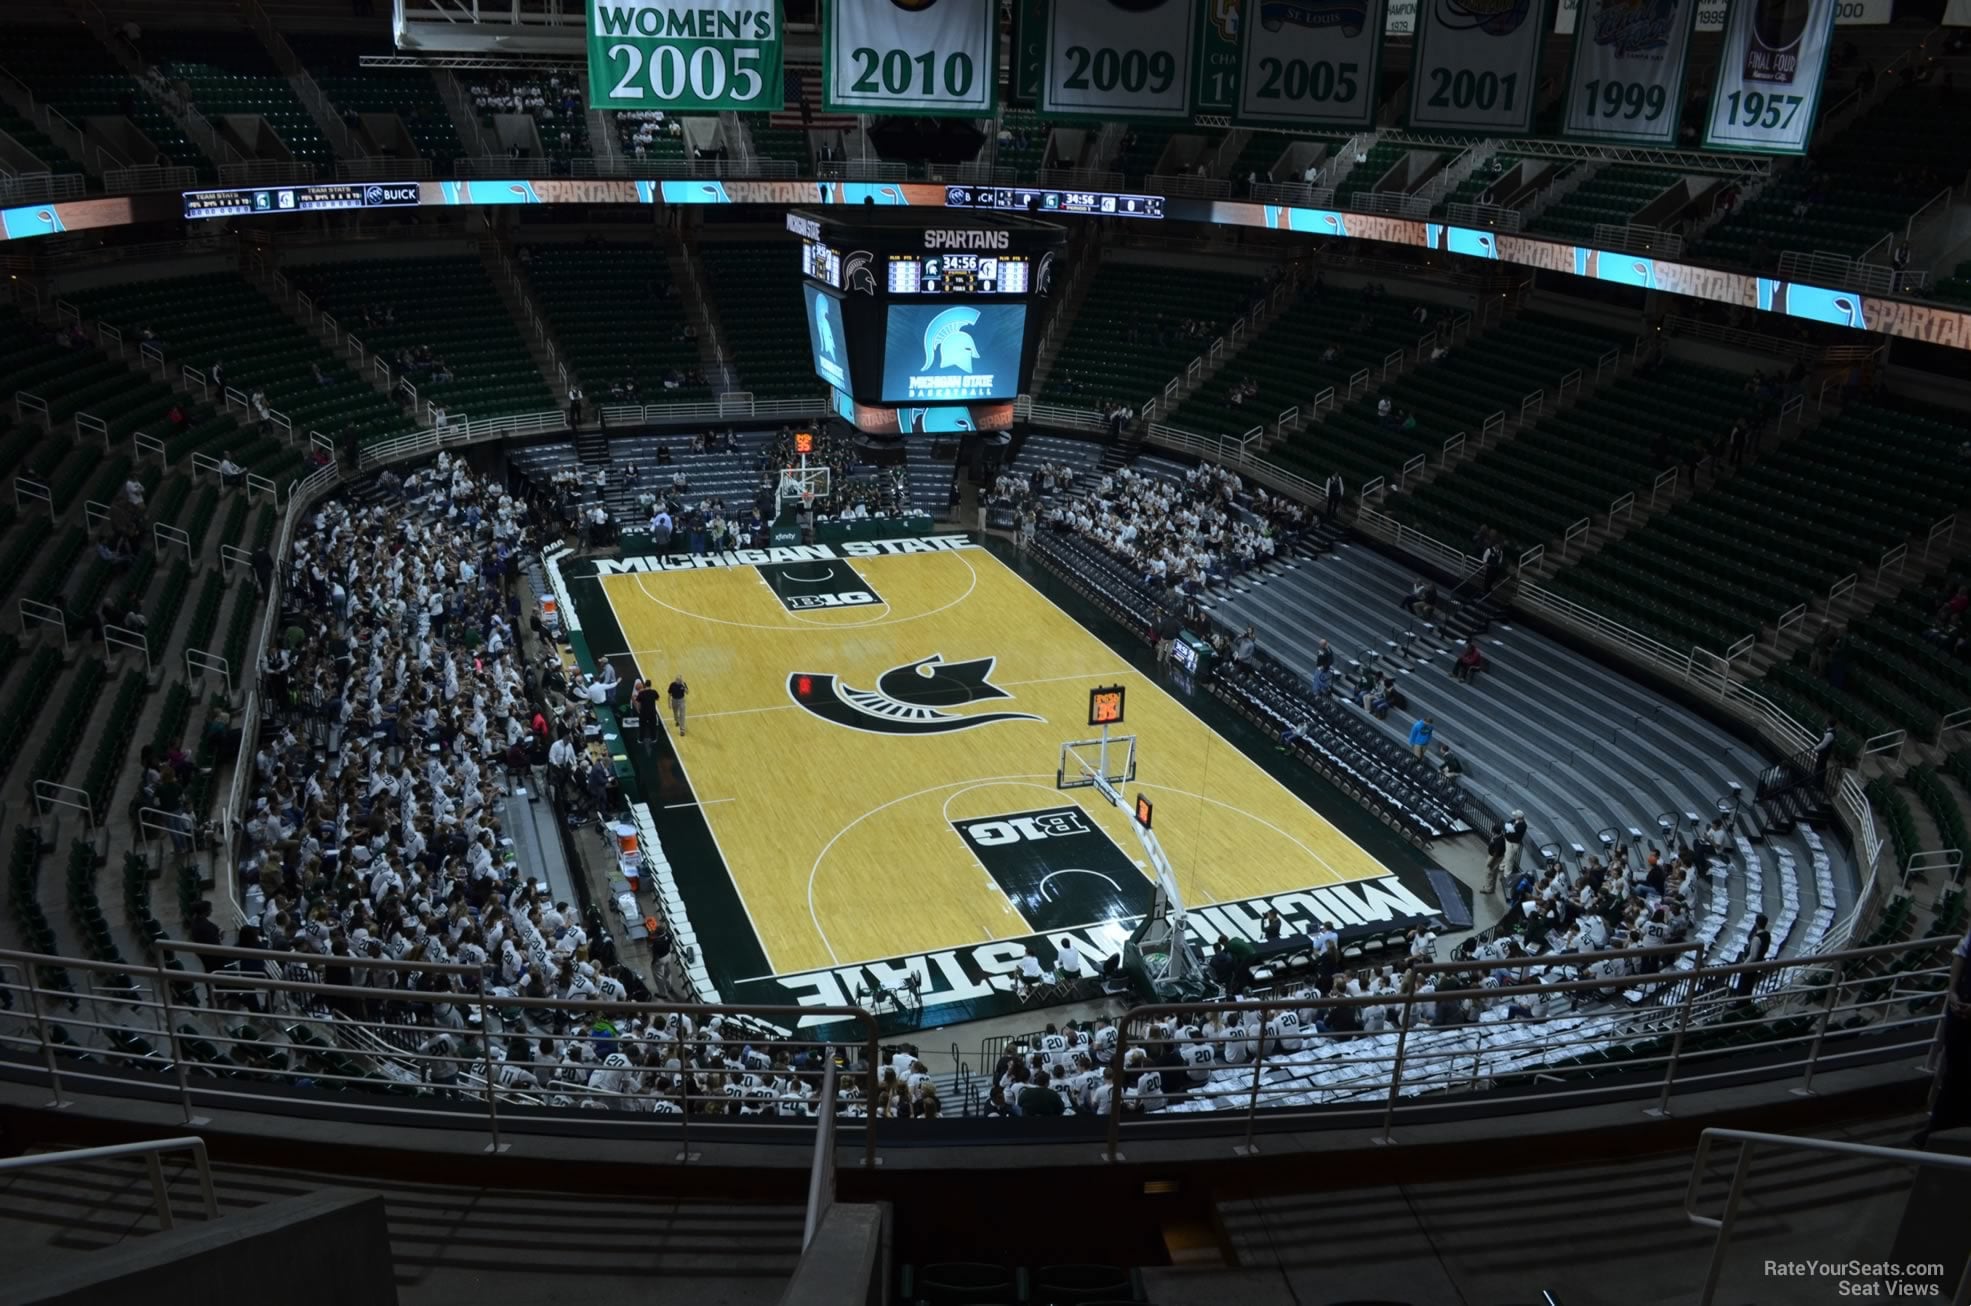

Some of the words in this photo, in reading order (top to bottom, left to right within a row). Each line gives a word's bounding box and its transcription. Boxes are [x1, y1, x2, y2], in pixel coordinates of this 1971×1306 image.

[599, 6, 771, 40] WOMEN'S
[1747, 50, 1770, 70] FINAL
[1772, 53, 1798, 72] FOUR
[607, 43, 764, 101] 2005
[850, 47, 974, 97] 2010
[1062, 46, 1176, 94] 2009
[1256, 57, 1359, 102] 2005
[1427, 67, 1518, 111] 2001
[1585, 79, 1667, 121] 1999
[1727, 90, 1804, 130] 1957
[384, 188, 417, 201] BUICK
[535, 181, 637, 203] SPARTANS
[724, 181, 819, 203] SPARTANS
[1065, 193, 1095, 205] 34:56
[1127, 199, 1136, 212] 0
[1344, 214, 1427, 247] SPARTANS
[924, 230, 1010, 249] SPARTANS
[1498, 235, 1575, 269] SPARTANS
[943, 256, 977, 270] 34:56
[927, 279, 935, 291] 0
[983, 279, 991, 291] 0
[1654, 260, 1757, 308] SPARTANS
[591, 544, 838, 576] MICHIGAN
[841, 534, 979, 557] STATE
[1649, 926, 1663, 938] 20
[504, 953, 514, 966] 20
[572, 974, 586, 990] 20
[601, 980, 616, 995] 20
[1281, 1014, 1297, 1027] 20
[1047, 1037, 1063, 1050] 20
[1106, 1030, 1117, 1043] 20
[429, 1039, 449, 1057] 20
[1195, 1049, 1211, 1063] 20
[606, 1054, 625, 1068] 20
[502, 1070, 514, 1084] 11
[1147, 1076, 1160, 1091] 20
